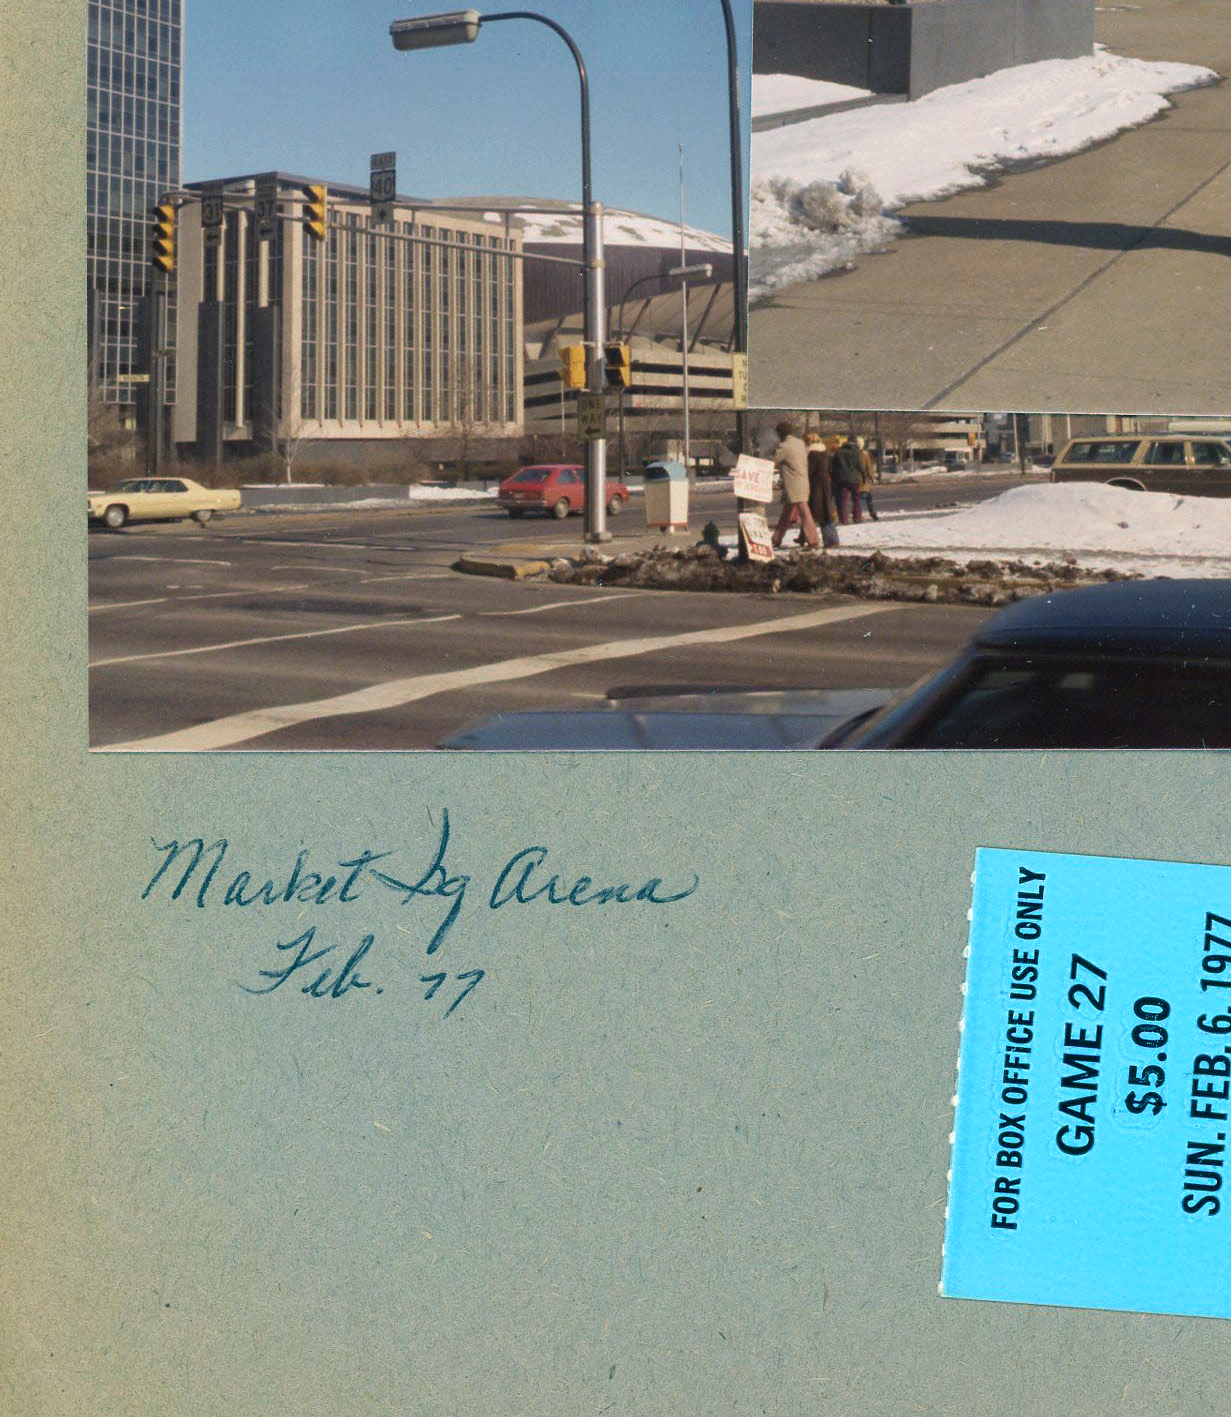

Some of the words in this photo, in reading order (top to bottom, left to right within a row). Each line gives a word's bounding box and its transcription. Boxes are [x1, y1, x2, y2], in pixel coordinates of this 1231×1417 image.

[373, 178, 392, 195] 40
[142, 838, 391, 909] Market
[373, 808, 468, 954] Sq
[490, 846, 699, 909] Arena
[1015, 867, 1045, 939] ONLY
[238, 925, 383, 1000] Feb.
[420, 969, 486, 1019] 77
[1010, 949, 1039, 1000] USE
[1068, 954, 1106, 1010] 27
[1002, 1010, 1034, 1104] OFFICE
[1056, 1023, 1102, 1155] GAME
[1125, 997, 1170, 1115] $5.00
[1190, 1046, 1231, 1120] FEB.
[996, 1113, 1025, 1168] BOX
[1182, 1133, 1225, 1215] SUN.
[991, 1177, 1020, 1229] FOR
